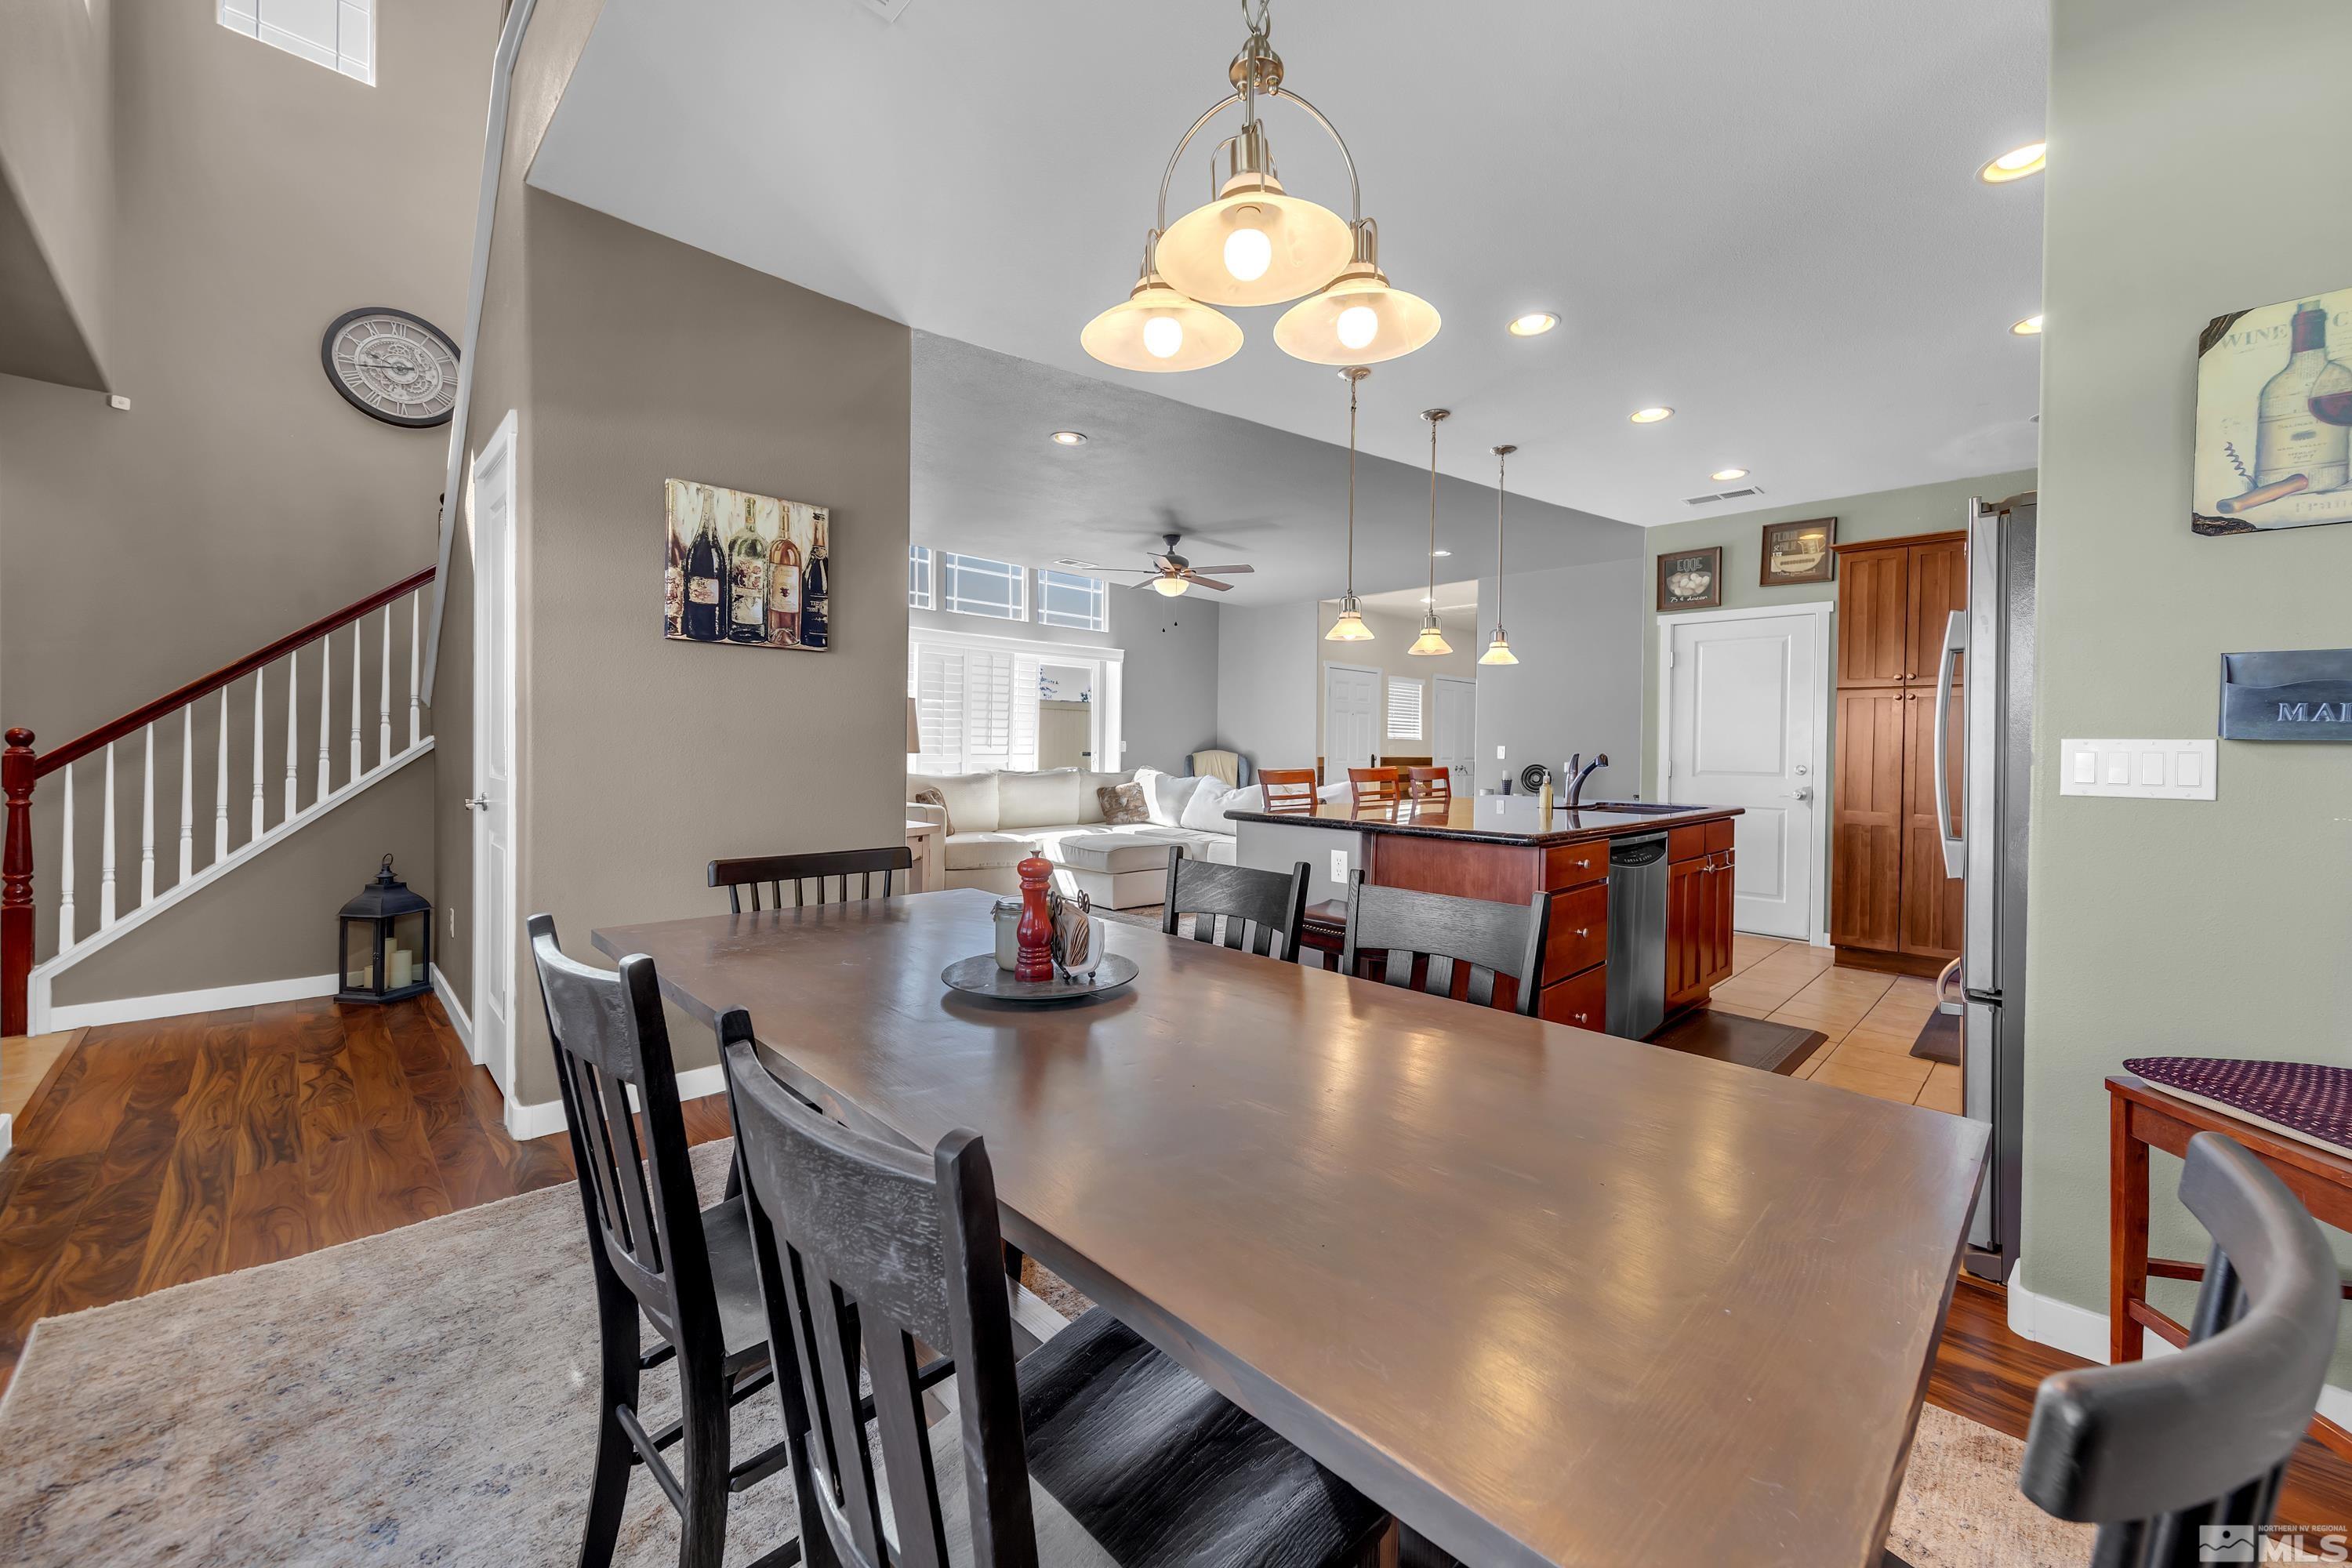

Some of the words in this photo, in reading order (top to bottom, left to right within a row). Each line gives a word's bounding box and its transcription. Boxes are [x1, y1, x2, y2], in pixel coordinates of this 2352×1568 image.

[363, 321, 379, 336] XI
[390, 321, 407, 338] XII
[344, 332, 362, 346] X
[2218, 324, 2288, 350] WINE
[396, 401, 408, 416] VI
